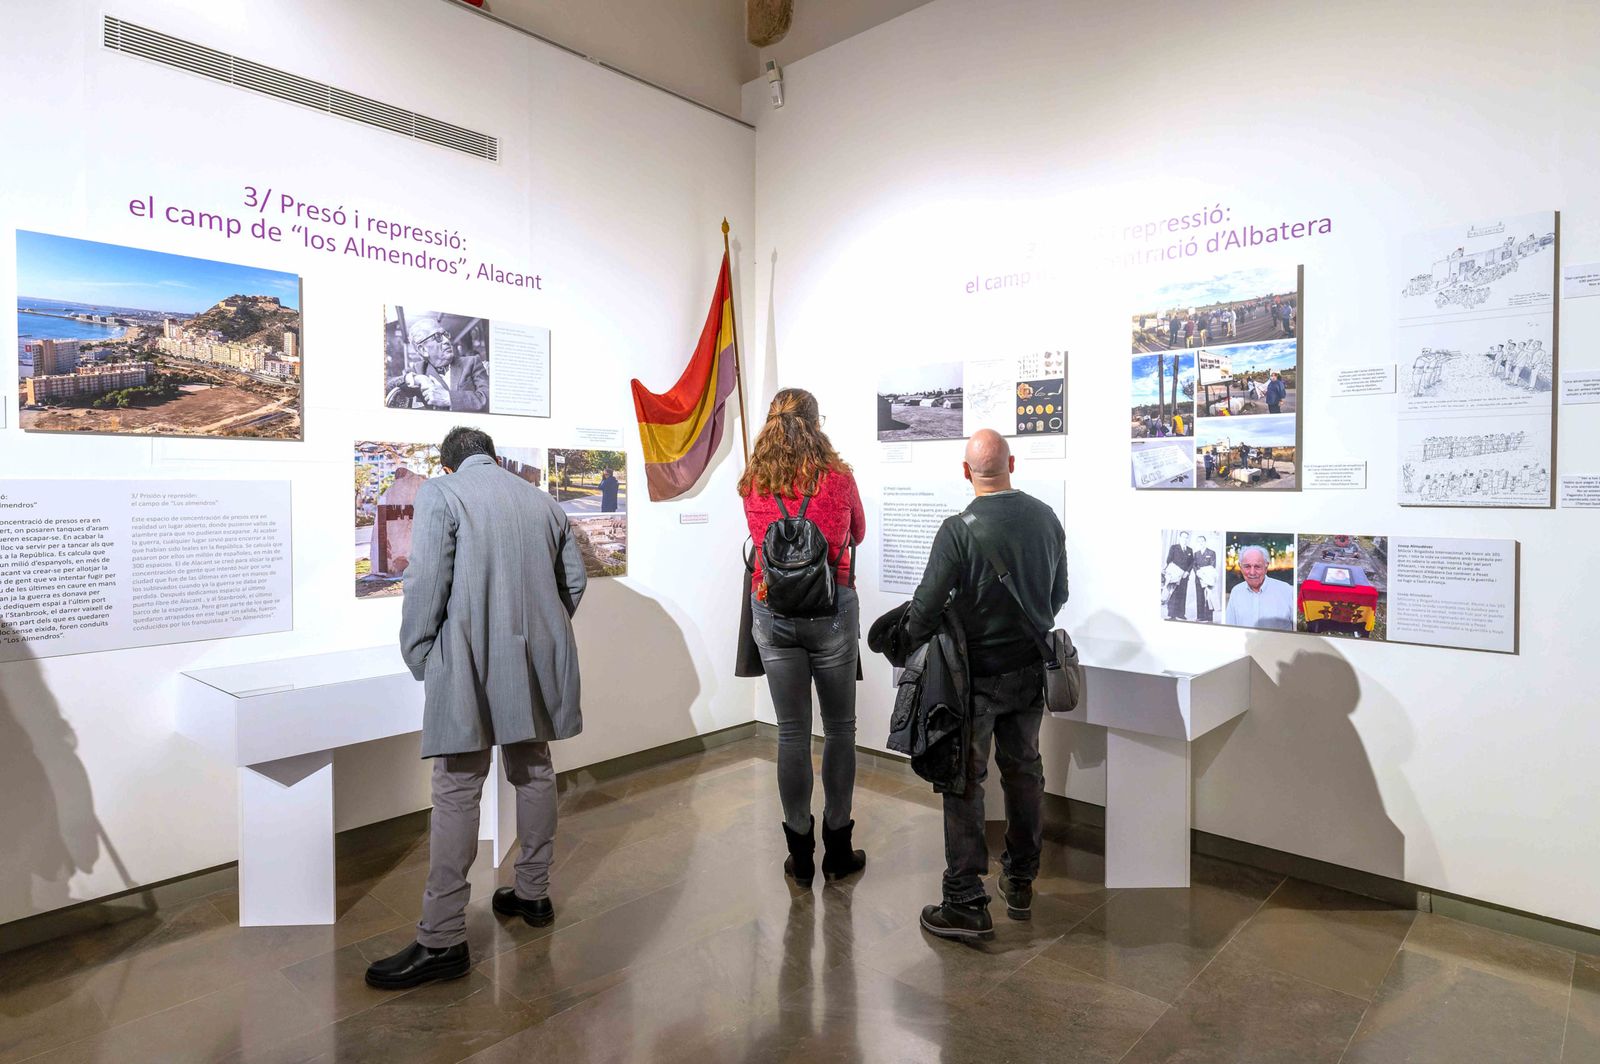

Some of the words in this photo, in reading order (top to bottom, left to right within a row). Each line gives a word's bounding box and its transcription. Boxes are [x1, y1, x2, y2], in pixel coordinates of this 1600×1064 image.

[244, 187, 271, 210] 3/
[282, 194, 346, 225] Presó
[354, 210, 359, 228] i
[368, 217, 467, 250] repressió:
[1122, 203, 1232, 242] repressió:
[129, 195, 153, 218] el
[166, 207, 241, 239] camp
[251, 219, 282, 241] de
[291, 224, 336, 252] “los
[343, 236, 471, 280] Almendros”,
[476, 263, 542, 290] Alacant
[965, 275, 979, 294] el
[984, 272, 1031, 291] camp
[1206, 216, 1333, 253] d’Albatera
[55, 518, 78, 526] presos
[25, 527, 55, 535] posaren
[56, 526, 84, 534] tanques
[85, 524, 108, 532] d’aram
[21, 535, 61, 543] escapar-se.
[73, 532, 96, 540] acabar
[25, 542, 46, 550] servir
[90, 540, 100, 548] als
[19, 550, 56, 560] República.
[67, 549, 91, 557] calcula
[11, 559, 29, 567] milió
[85, 556, 100, 564] més
[63, 567, 75, 575] per
[76, 564, 100, 573] allotjar
[15, 577, 31, 586] gent
[33, 577, 47, 585] que
[58, 574, 86, 582] intentar
[87, 572, 103, 581] fugir
[104, 573, 116, 581] per
[10, 594, 17, 603] ja
[27, 593, 50, 602] guerra
[61, 590, 87, 598] donava
[88, 590, 100, 598] per
[4, 602, 40, 610] dediquem
[42, 599, 60, 608] espai
[91, 597, 105, 606] port
[50, 607, 57, 615] el
[82, 604, 103, 612] vaixell
[104, 603, 112, 611] de
[1, 621, 18, 629] gran
[19, 618, 34, 628] part
[52, 617, 66, 625] que
[77, 613, 109, 623] quedaren
[34, 624, 57, 633] eixida,
[59, 623, 78, 631] foren
